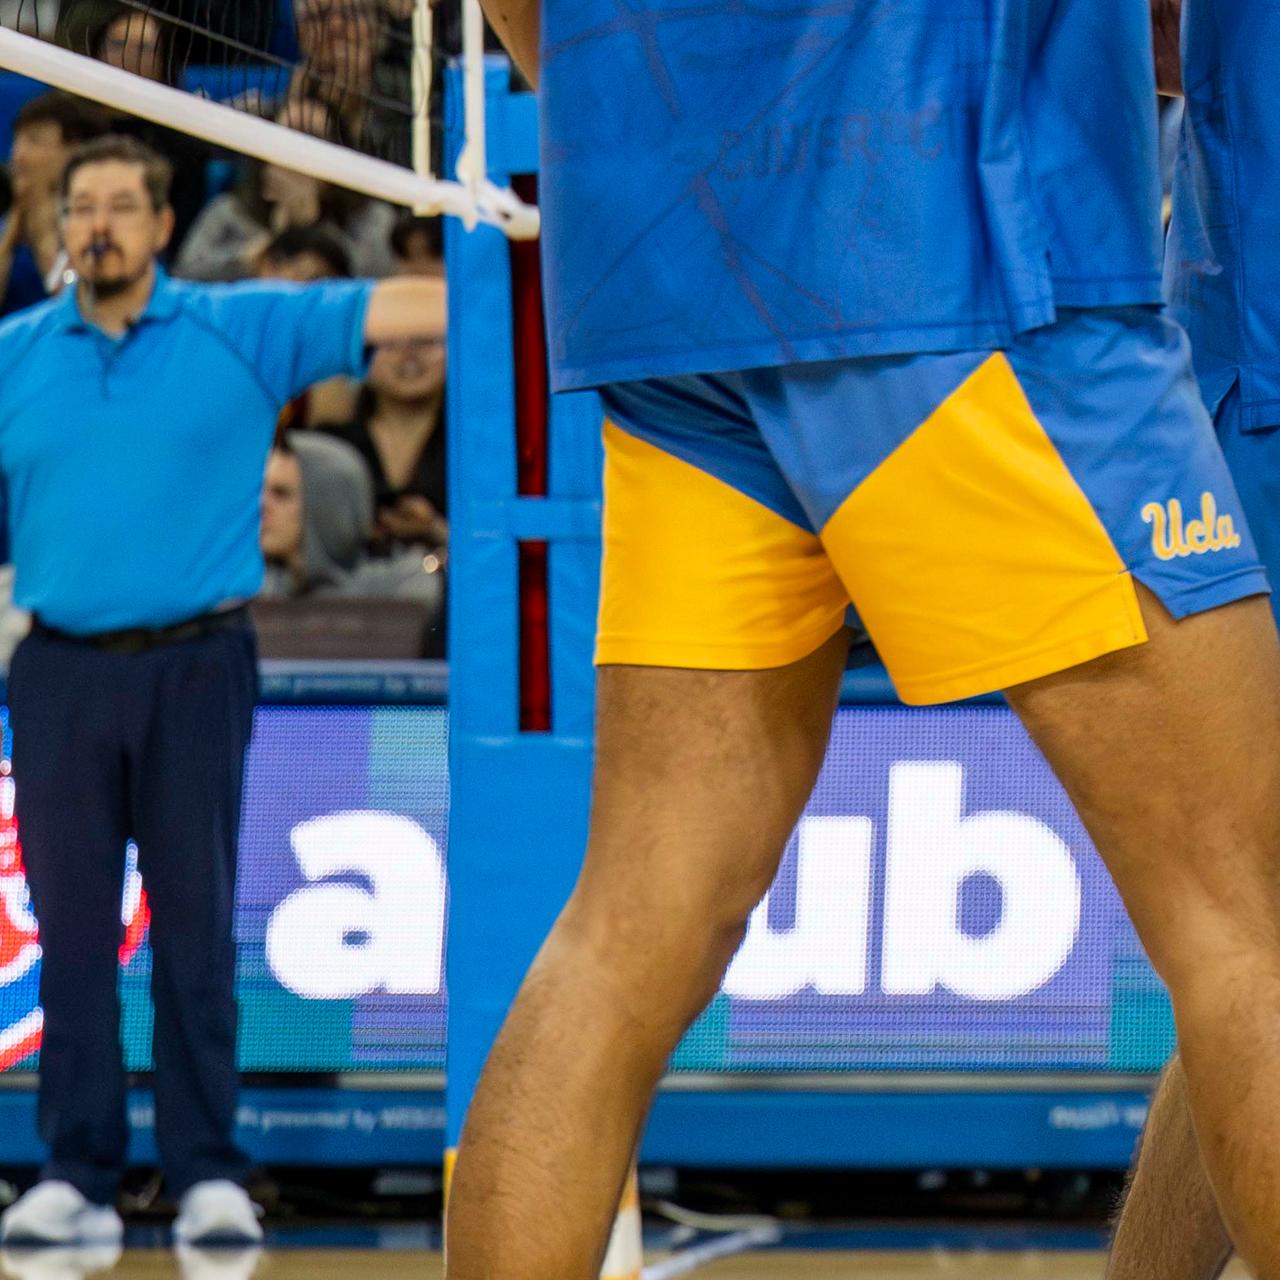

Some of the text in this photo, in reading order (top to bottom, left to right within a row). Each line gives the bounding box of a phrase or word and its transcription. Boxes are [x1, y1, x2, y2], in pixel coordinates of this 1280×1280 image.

[1141, 491, 1241, 561] Ucla
[266, 810, 444, 1000] a
[721, 760, 1082, 1001] ub
